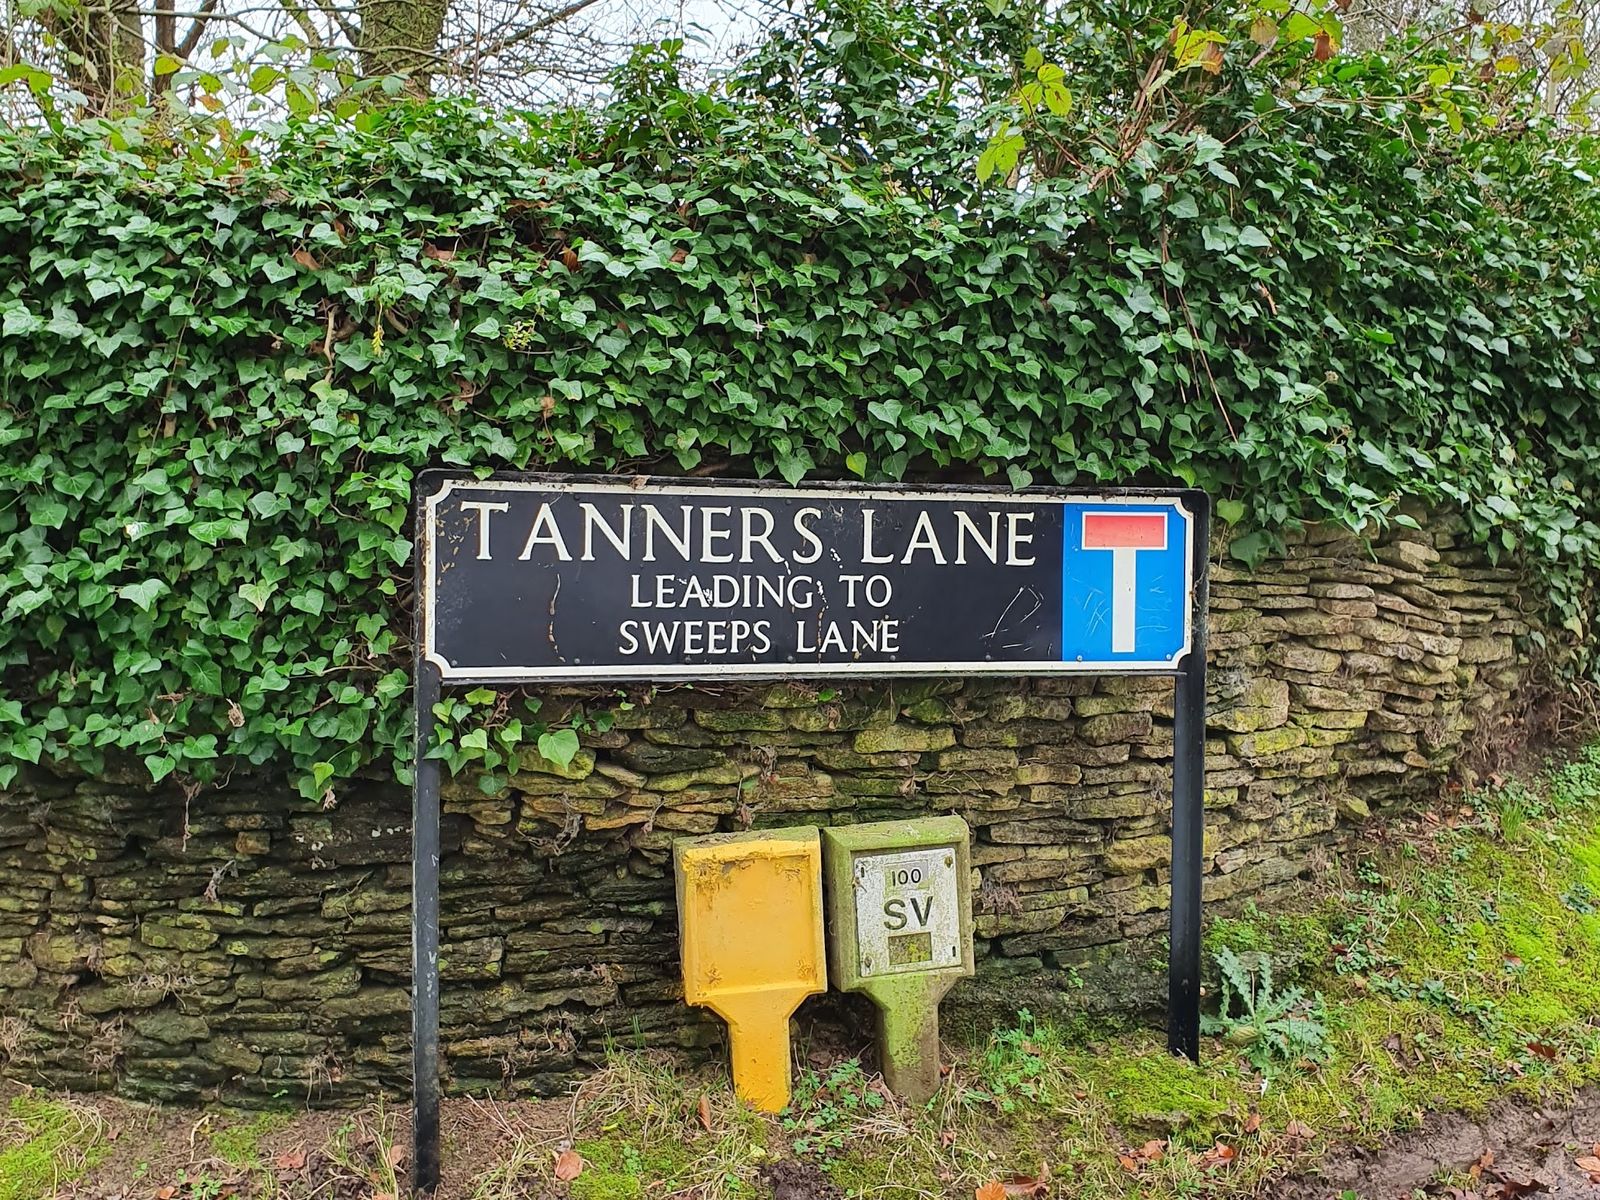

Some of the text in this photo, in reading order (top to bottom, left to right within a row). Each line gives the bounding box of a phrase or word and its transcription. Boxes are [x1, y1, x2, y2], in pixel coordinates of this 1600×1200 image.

[460, 501, 1037, 566] TANNERS LANE
[631, 574, 893, 611] LEADING TO
[619, 619, 900, 656] SWEEPS LANE
[891, 868, 922, 887] 100
[884, 895, 934, 930] SV
